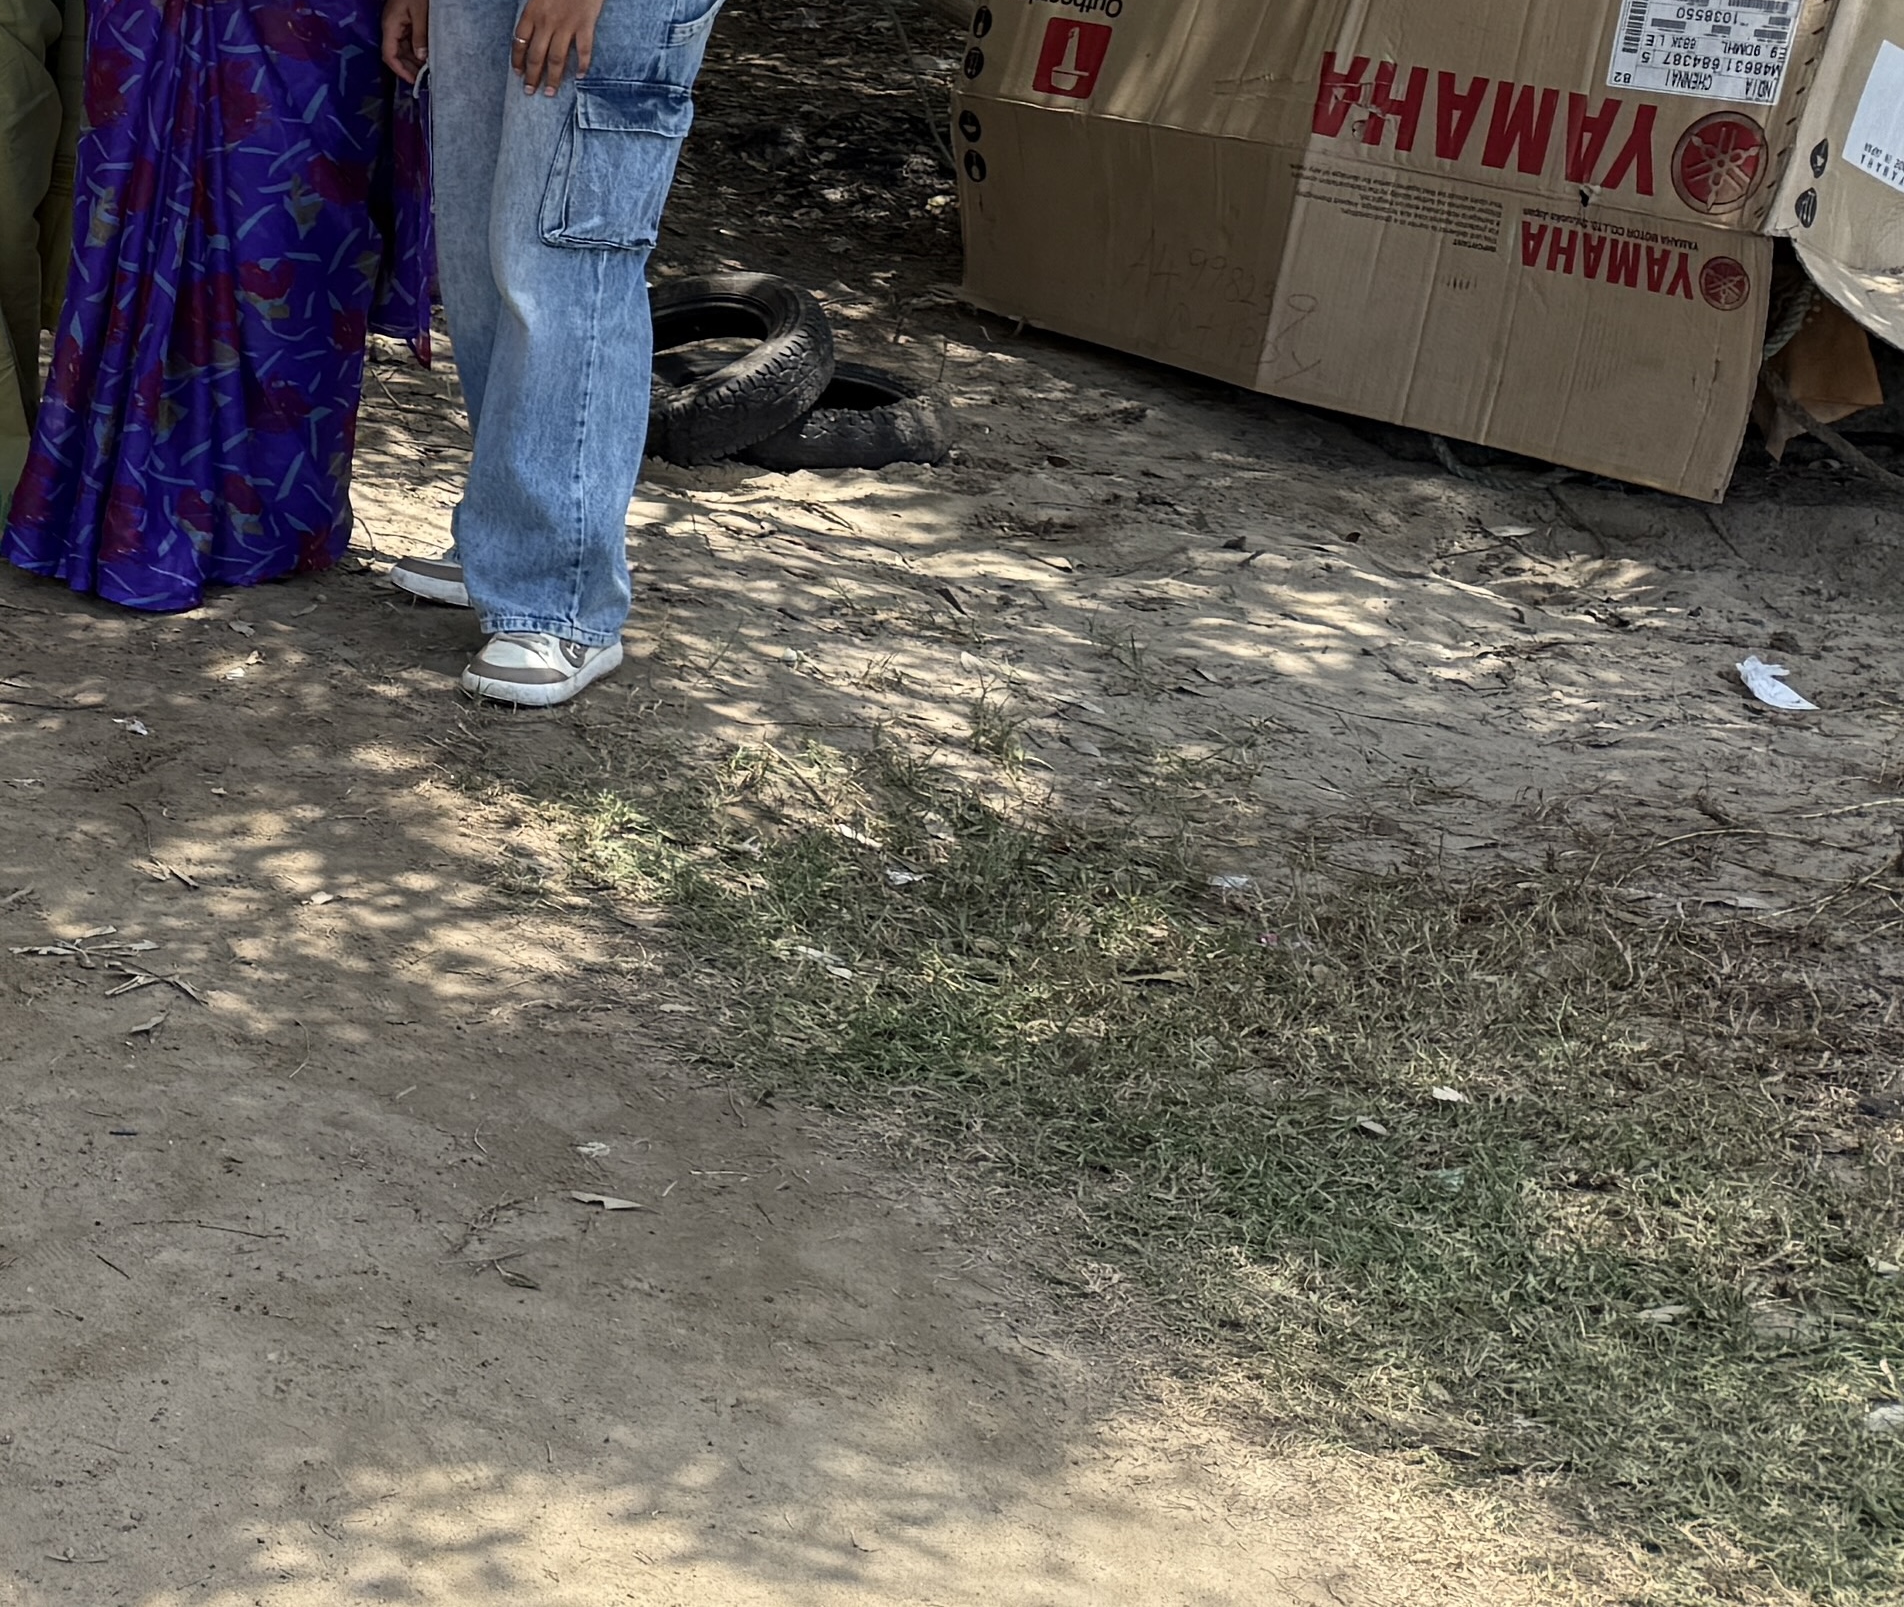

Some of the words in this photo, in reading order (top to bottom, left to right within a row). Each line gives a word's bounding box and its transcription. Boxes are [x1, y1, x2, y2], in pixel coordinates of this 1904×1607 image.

[1677, 7, 1738, 25] 1038550
[1641, 51, 1652, 63] 5
[1666, 69, 1712, 91] CHENNAI
[1312, 52, 1657, 196] YAMAHA
[1627, 229, 1659, 243] MOTOR
[1661, 234, 1699, 251] YAMAHA
[1522, 221, 1693, 300] YAMAHA
